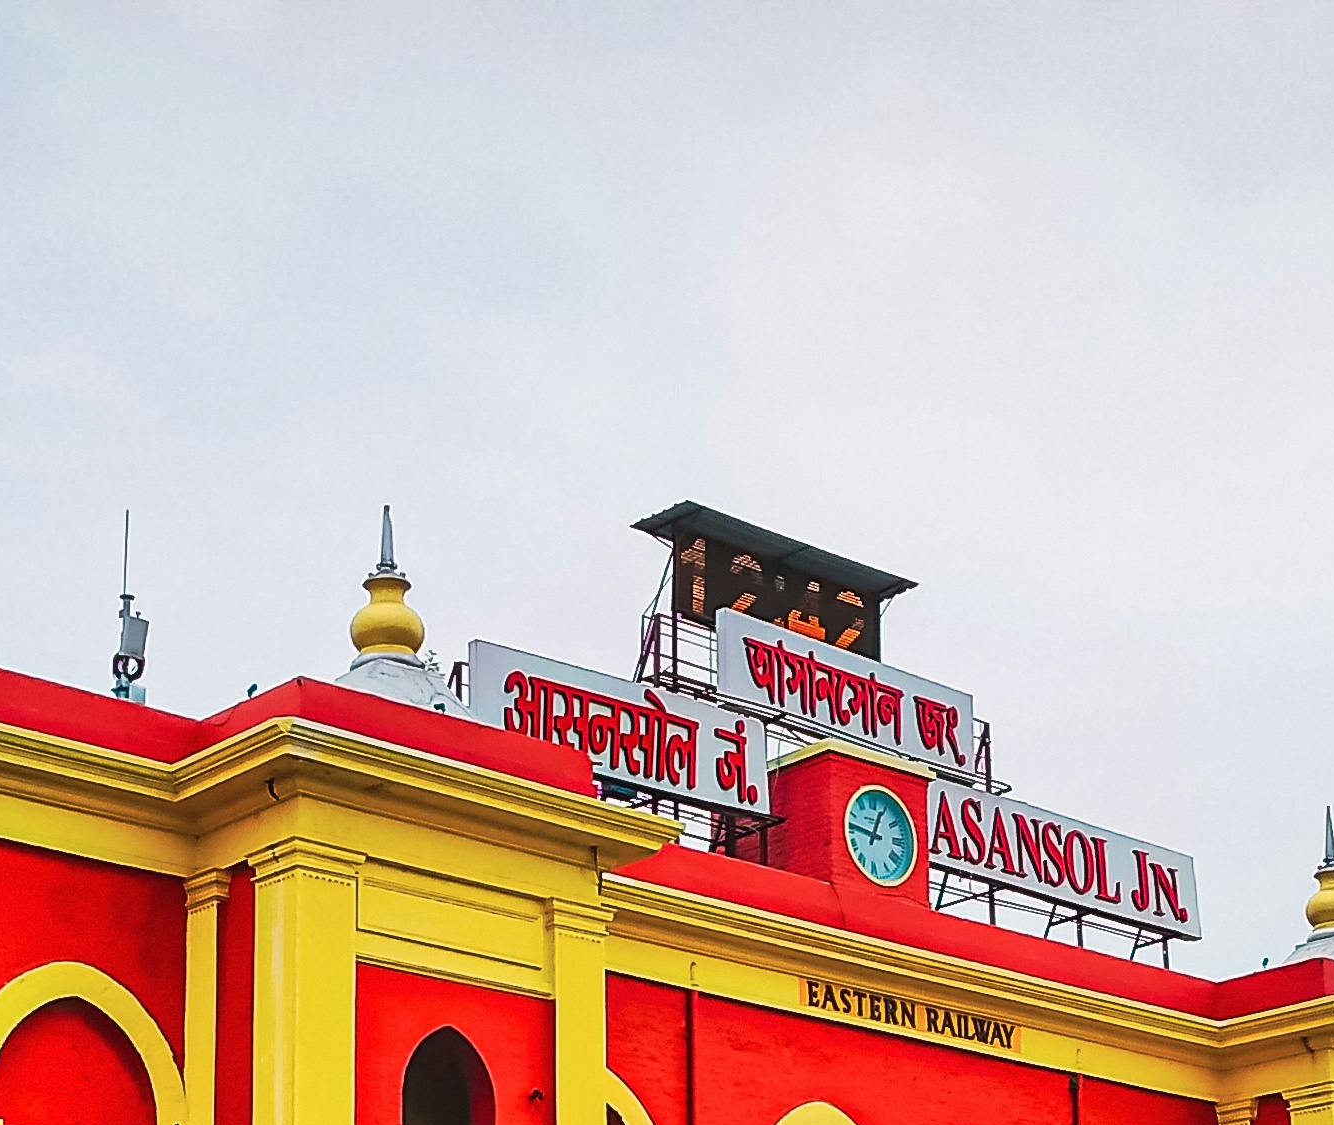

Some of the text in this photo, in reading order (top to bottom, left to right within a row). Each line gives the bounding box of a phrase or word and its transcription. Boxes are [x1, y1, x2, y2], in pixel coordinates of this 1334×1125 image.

[504, 670, 699, 790] आसनसोल
[743, 637, 904, 745] আসানসোল
[929, 790, 1189, 923] ASANSOL JN.
[806, 980, 1015, 1049] EASTERN RAILWAY
